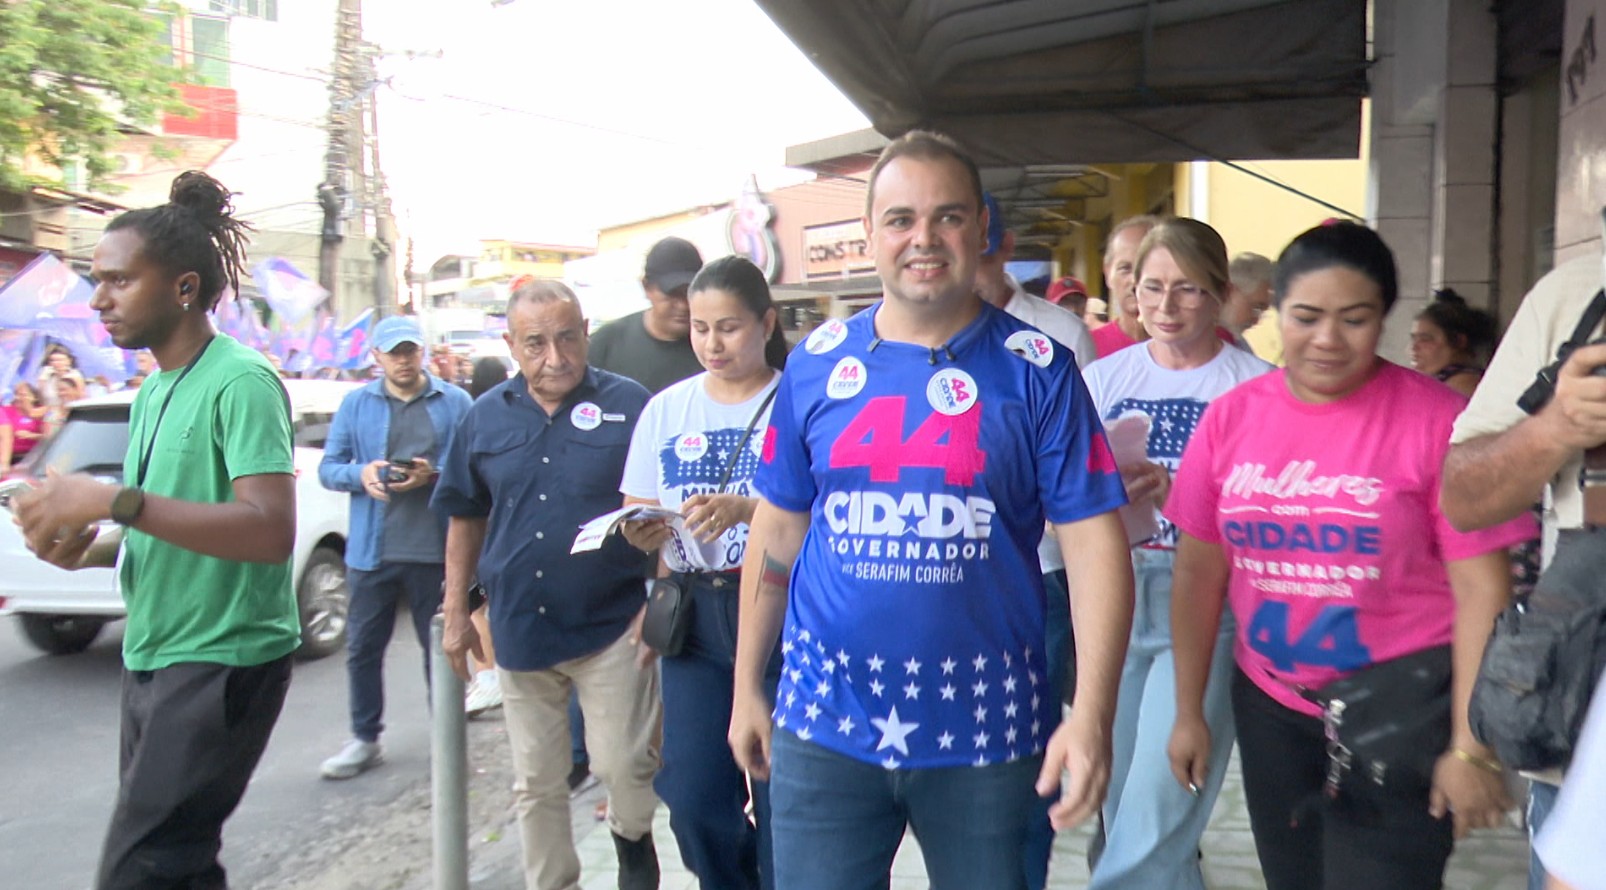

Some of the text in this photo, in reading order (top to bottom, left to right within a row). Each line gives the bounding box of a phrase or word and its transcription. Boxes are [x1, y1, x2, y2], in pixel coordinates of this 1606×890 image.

[1033, 338, 1050, 355] 44
[838, 365, 859, 380] 44
[951, 377, 971, 403] 44
[682, 436, 702, 447] 44
[830, 396, 986, 487] 44
[1222, 460, 1383, 506] Mulheres
[824, 490, 996, 540] CIDADE
[1224, 520, 1381, 554] CIDADE
[855, 562, 911, 583] SERAFIM
[915, 562, 964, 584] CORRÊA
[1246, 600, 1372, 673] 44
